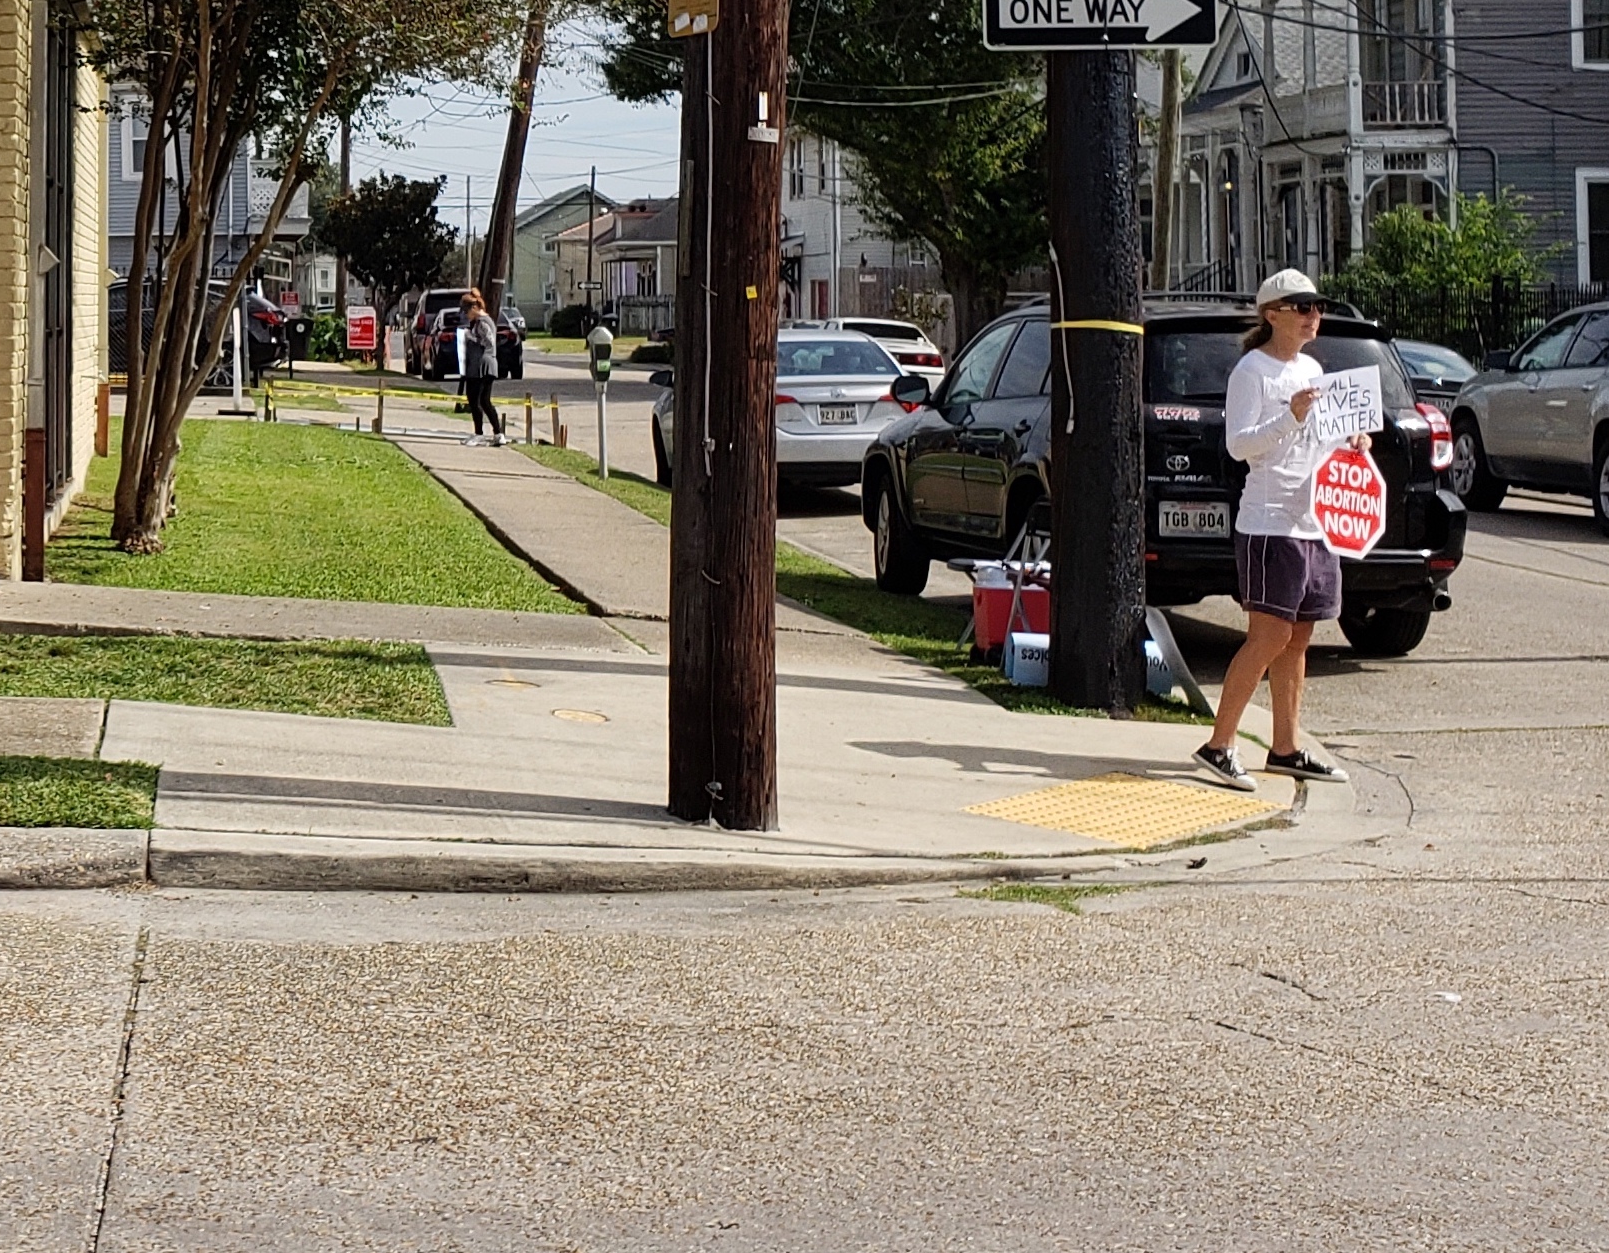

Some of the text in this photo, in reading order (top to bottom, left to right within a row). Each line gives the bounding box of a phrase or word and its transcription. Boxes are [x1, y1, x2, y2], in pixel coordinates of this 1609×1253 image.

[1328, 375, 1360, 392] ALL
[1318, 389, 1371, 414] LIVES
[1319, 409, 1379, 436] MATTER
[1328, 460, 1373, 490] STOP
[1315, 483, 1381, 517] ABORTION
[1163, 511, 1225, 529] TGB 804
[1324, 510, 1371, 541] NOW
